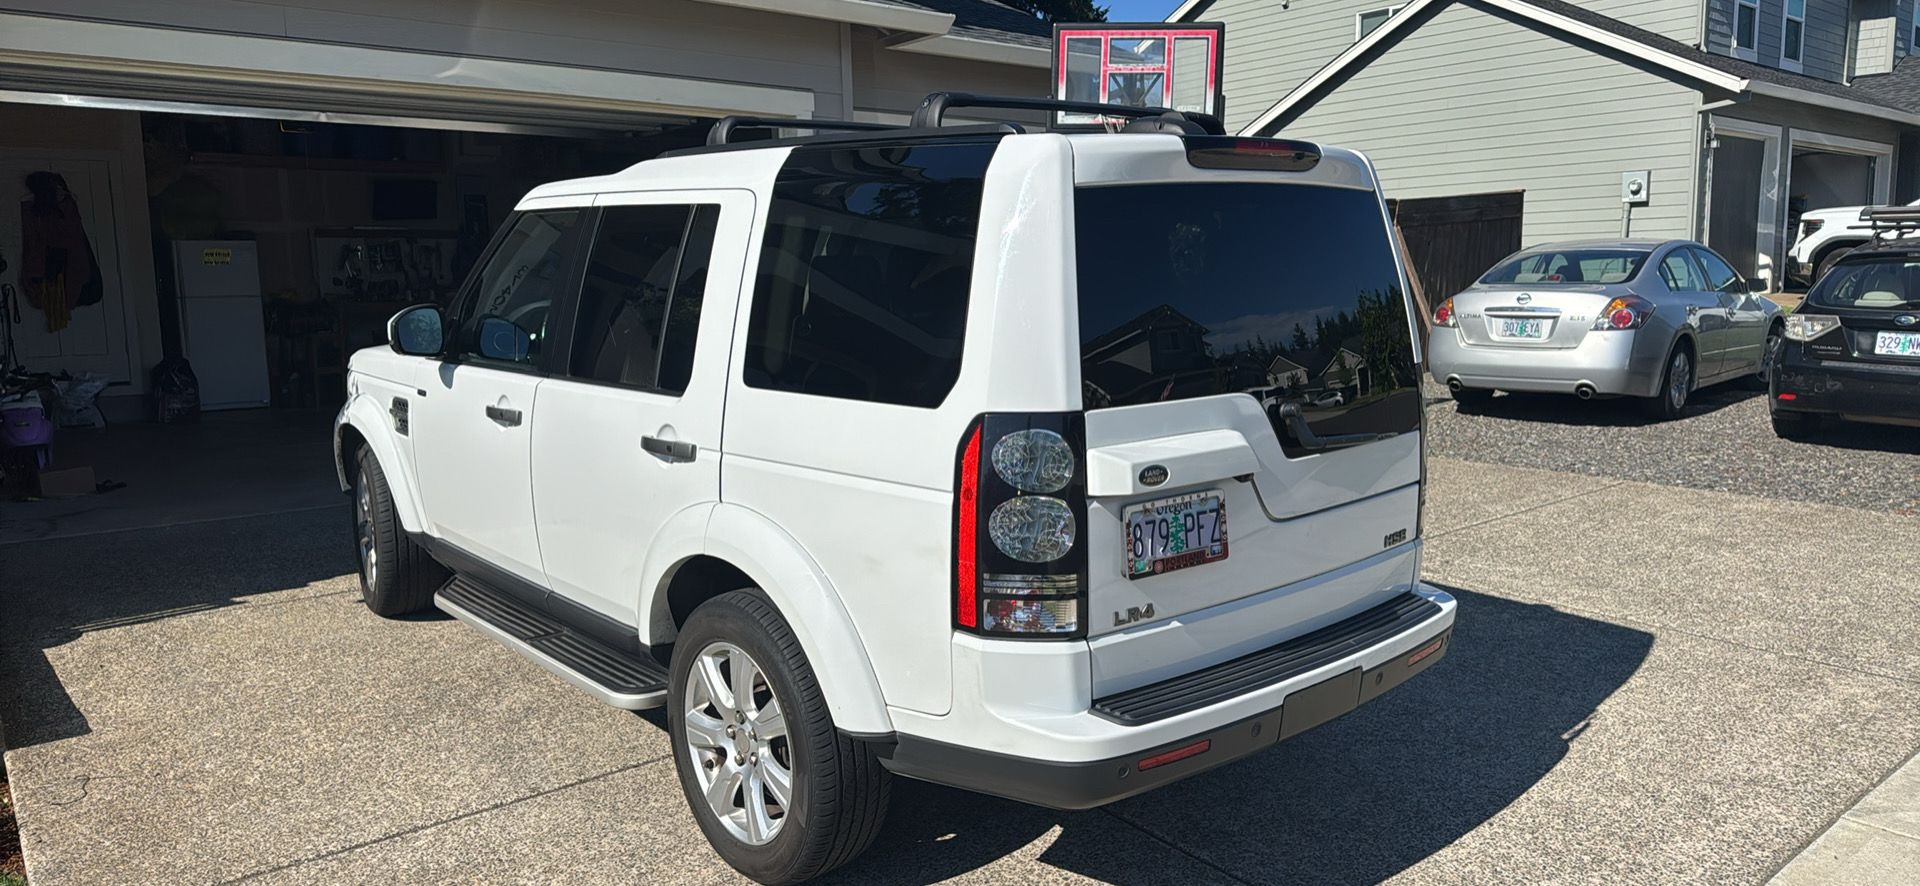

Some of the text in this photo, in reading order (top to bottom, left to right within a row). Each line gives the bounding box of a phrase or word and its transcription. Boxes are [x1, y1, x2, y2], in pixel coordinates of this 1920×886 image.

[1504, 321, 1519, 333] 307
[1879, 335, 1902, 350] 329
[1156, 500, 1193, 516] Oregon
[1132, 507, 1222, 559] 879 PFZ
[1113, 602, 1155, 627] LR4
